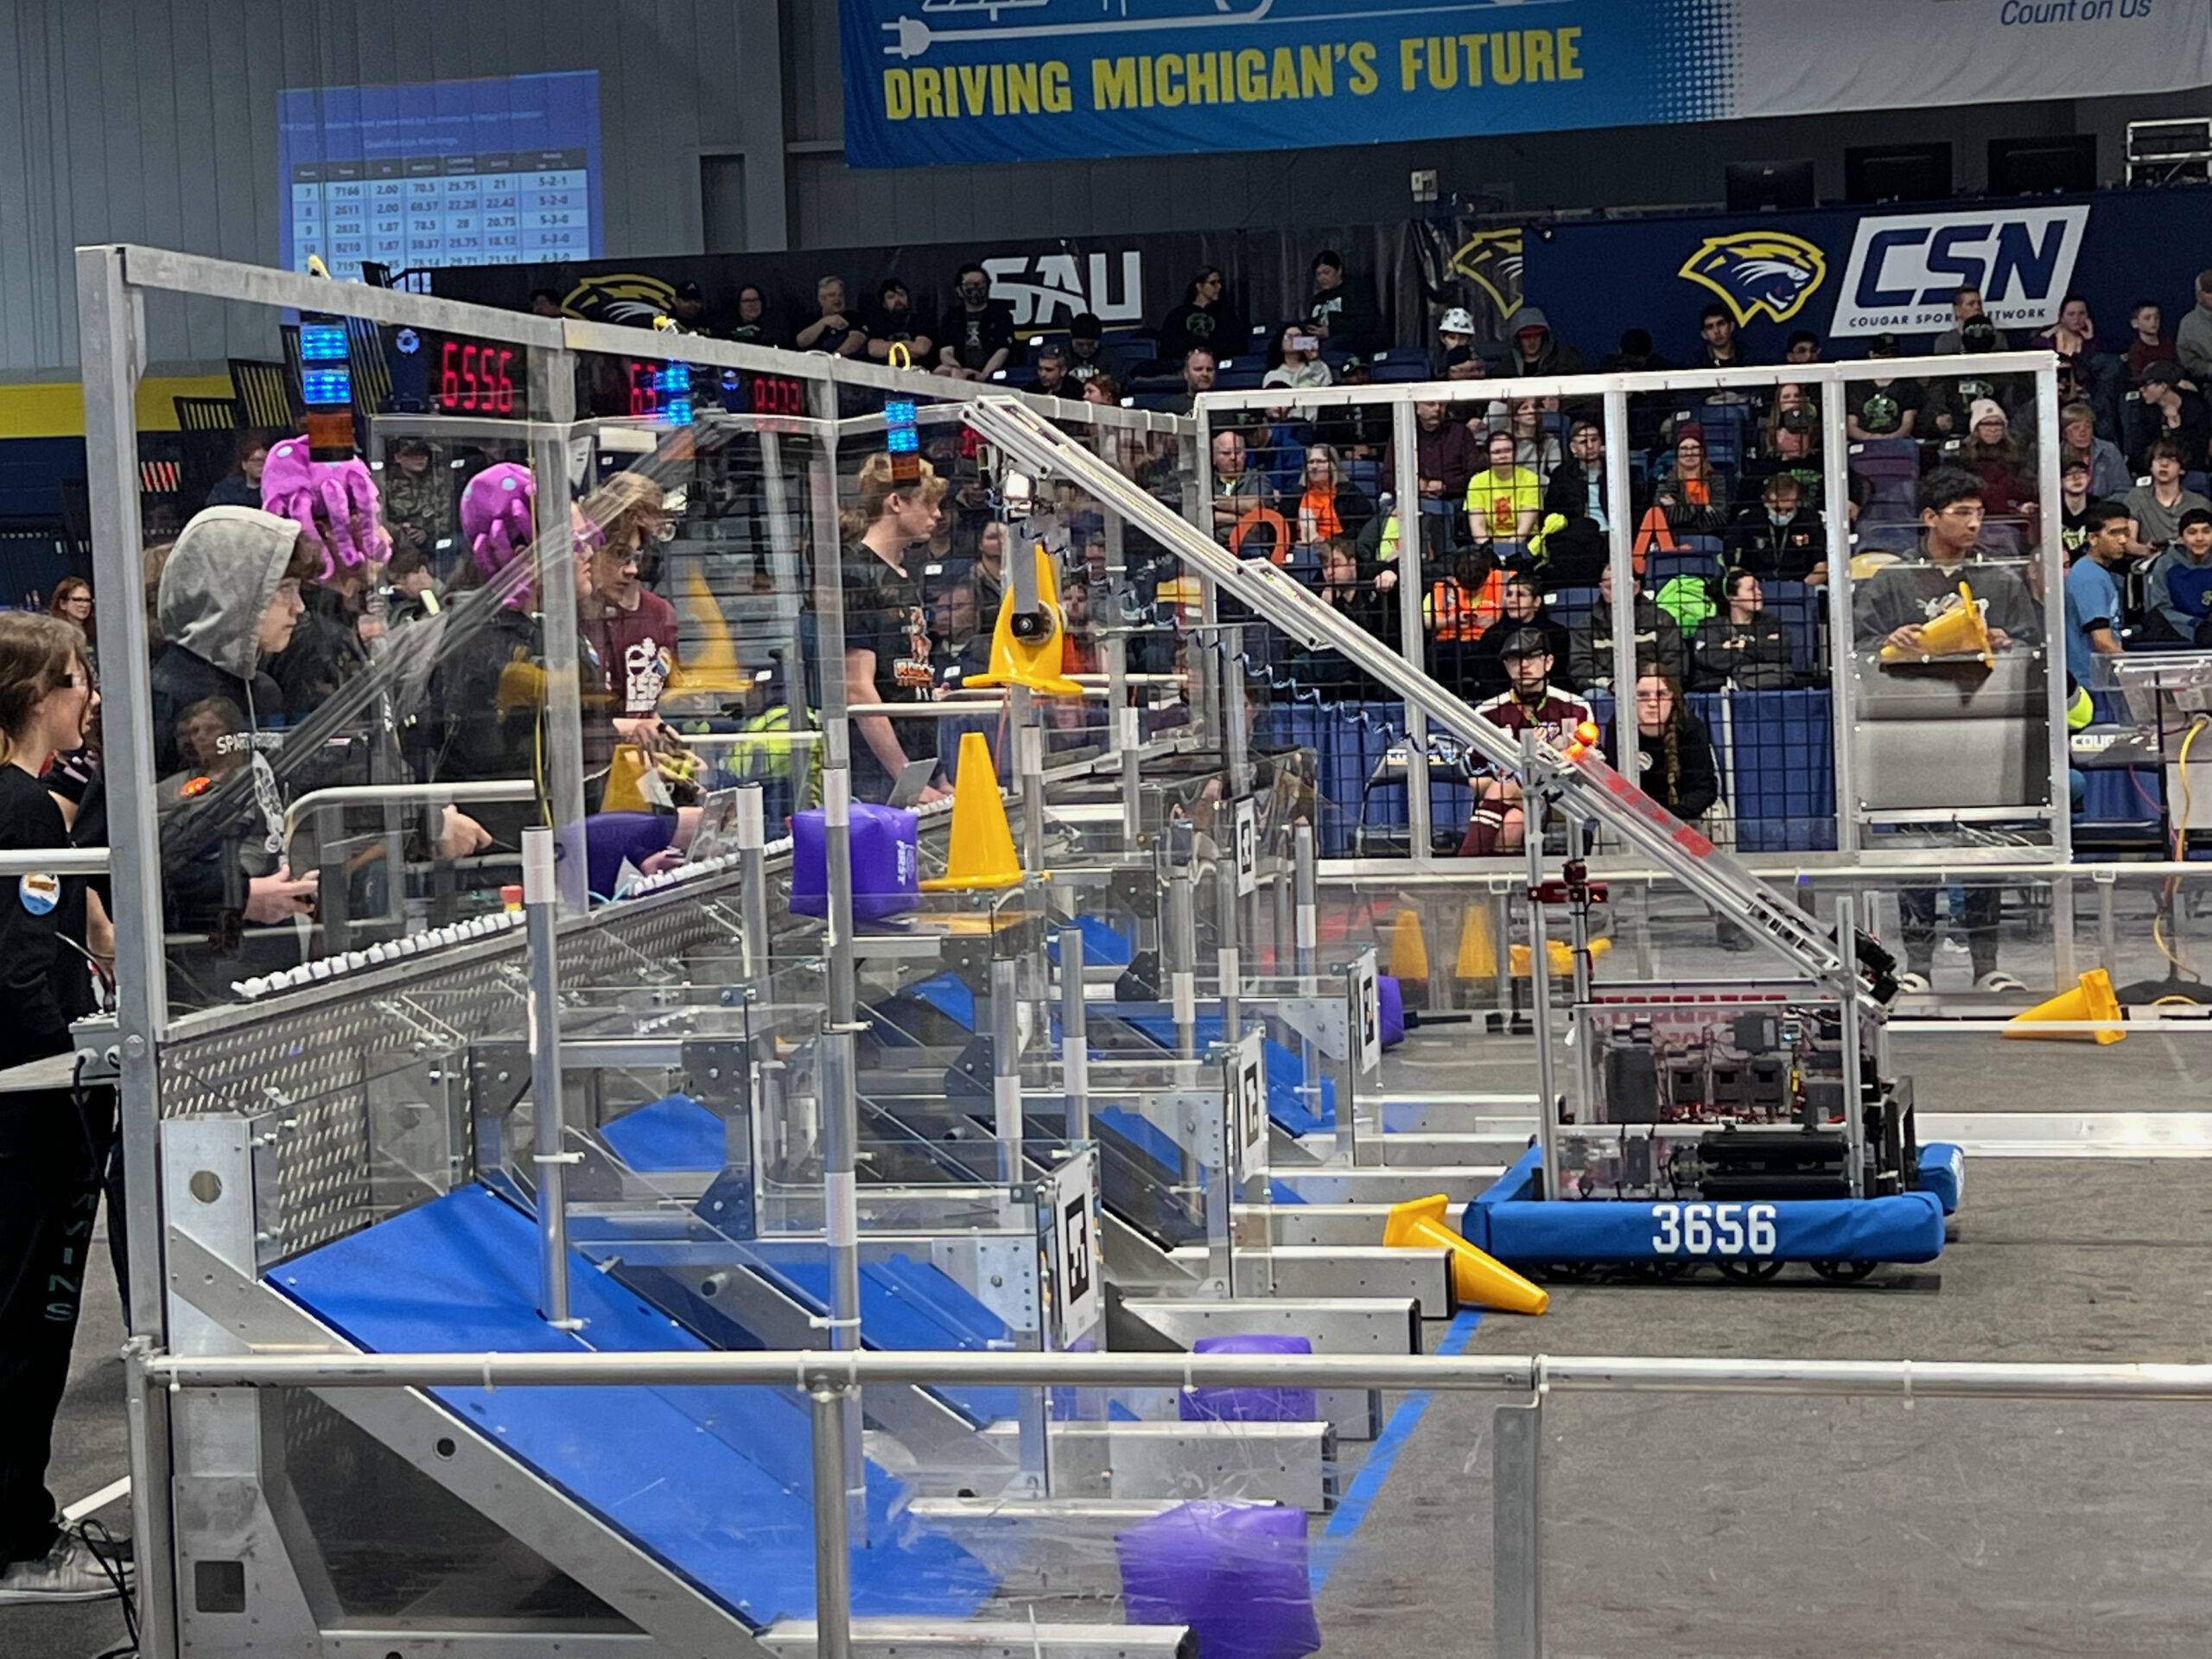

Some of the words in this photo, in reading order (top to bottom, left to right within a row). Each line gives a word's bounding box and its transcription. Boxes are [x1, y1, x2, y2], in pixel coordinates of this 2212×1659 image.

[2000, 0, 2075, 25] Count
[2081, 0, 2113, 21] on
[2120, 0, 2152, 18] Us
[883, 60, 1072, 119] DRIVING
[1091, 41, 1378, 111] MICHIGAN'S
[1400, 27, 1584, 92] FUTURE
[376, 185, 398, 195] 2.00
[493, 180, 506, 189] 21
[982, 251, 1142, 325] SAU
[1854, 219, 2068, 308] CSN
[1849, 315, 1909, 327] COUGAR
[1916, 311, 1958, 324] SPOR
[1987, 307, 2046, 321] ETWORK
[442, 341, 512, 412] 6556
[1652, 1204, 1777, 1255] 3656
